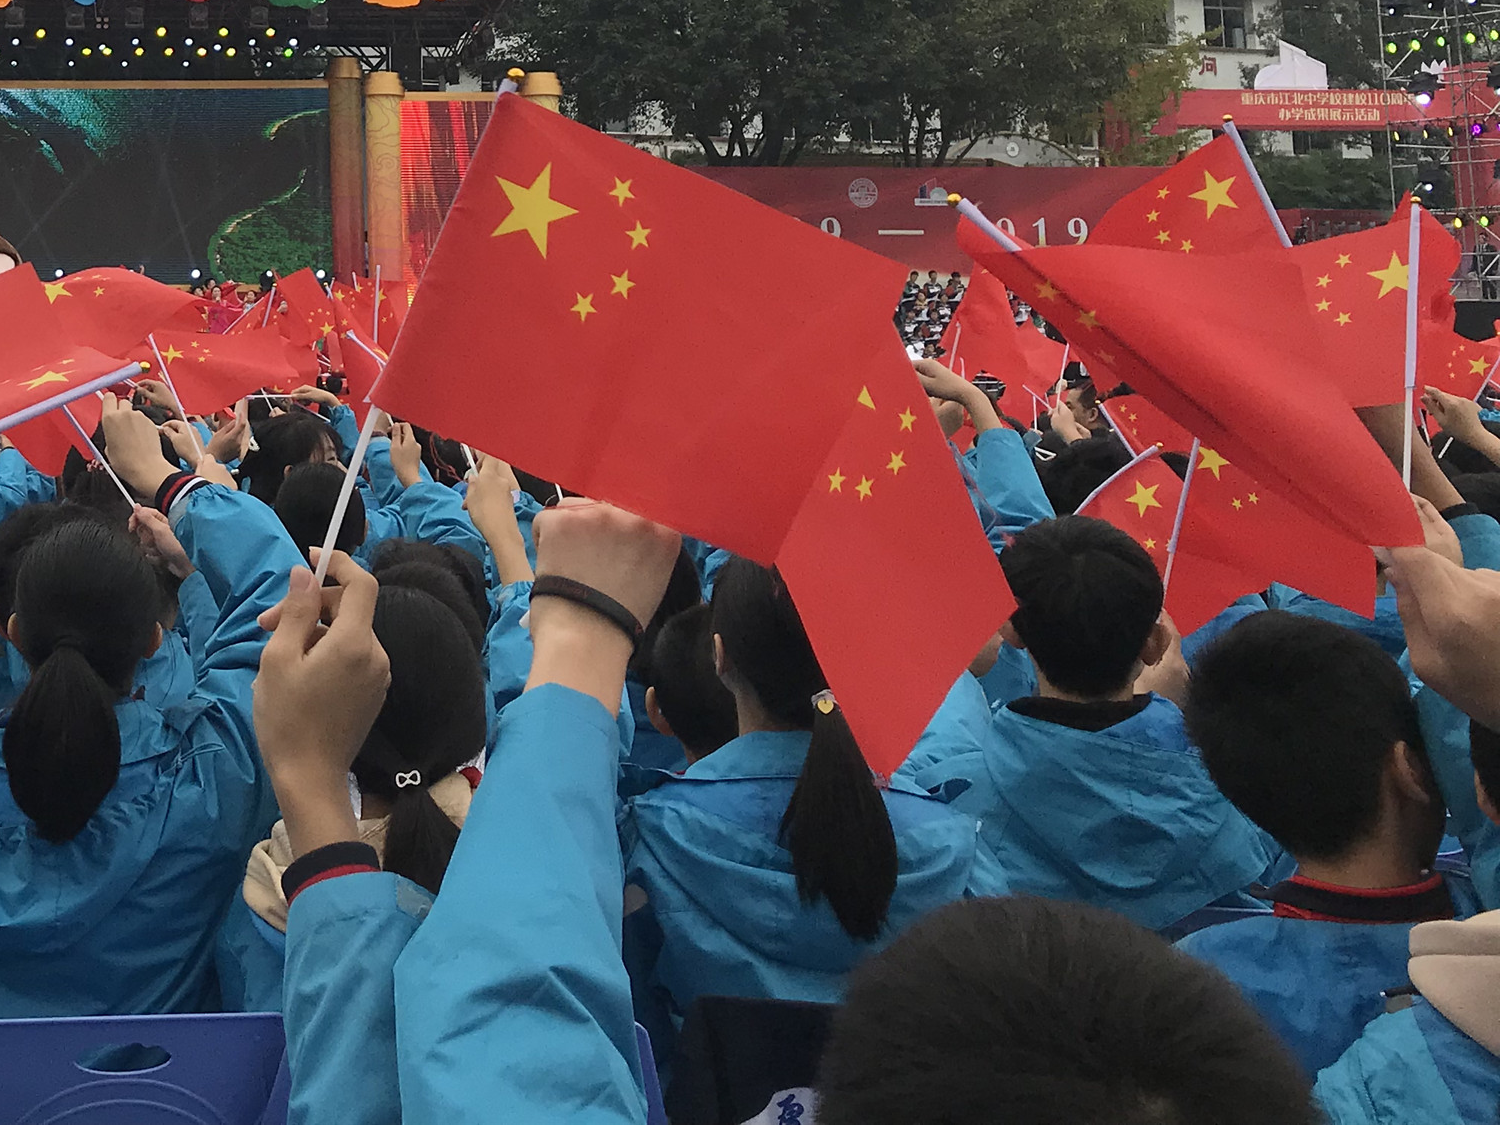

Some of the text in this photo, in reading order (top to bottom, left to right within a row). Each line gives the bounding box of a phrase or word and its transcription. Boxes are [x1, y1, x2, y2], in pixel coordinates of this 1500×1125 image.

[1278, 107, 1381, 122] 办学成果展示活动
